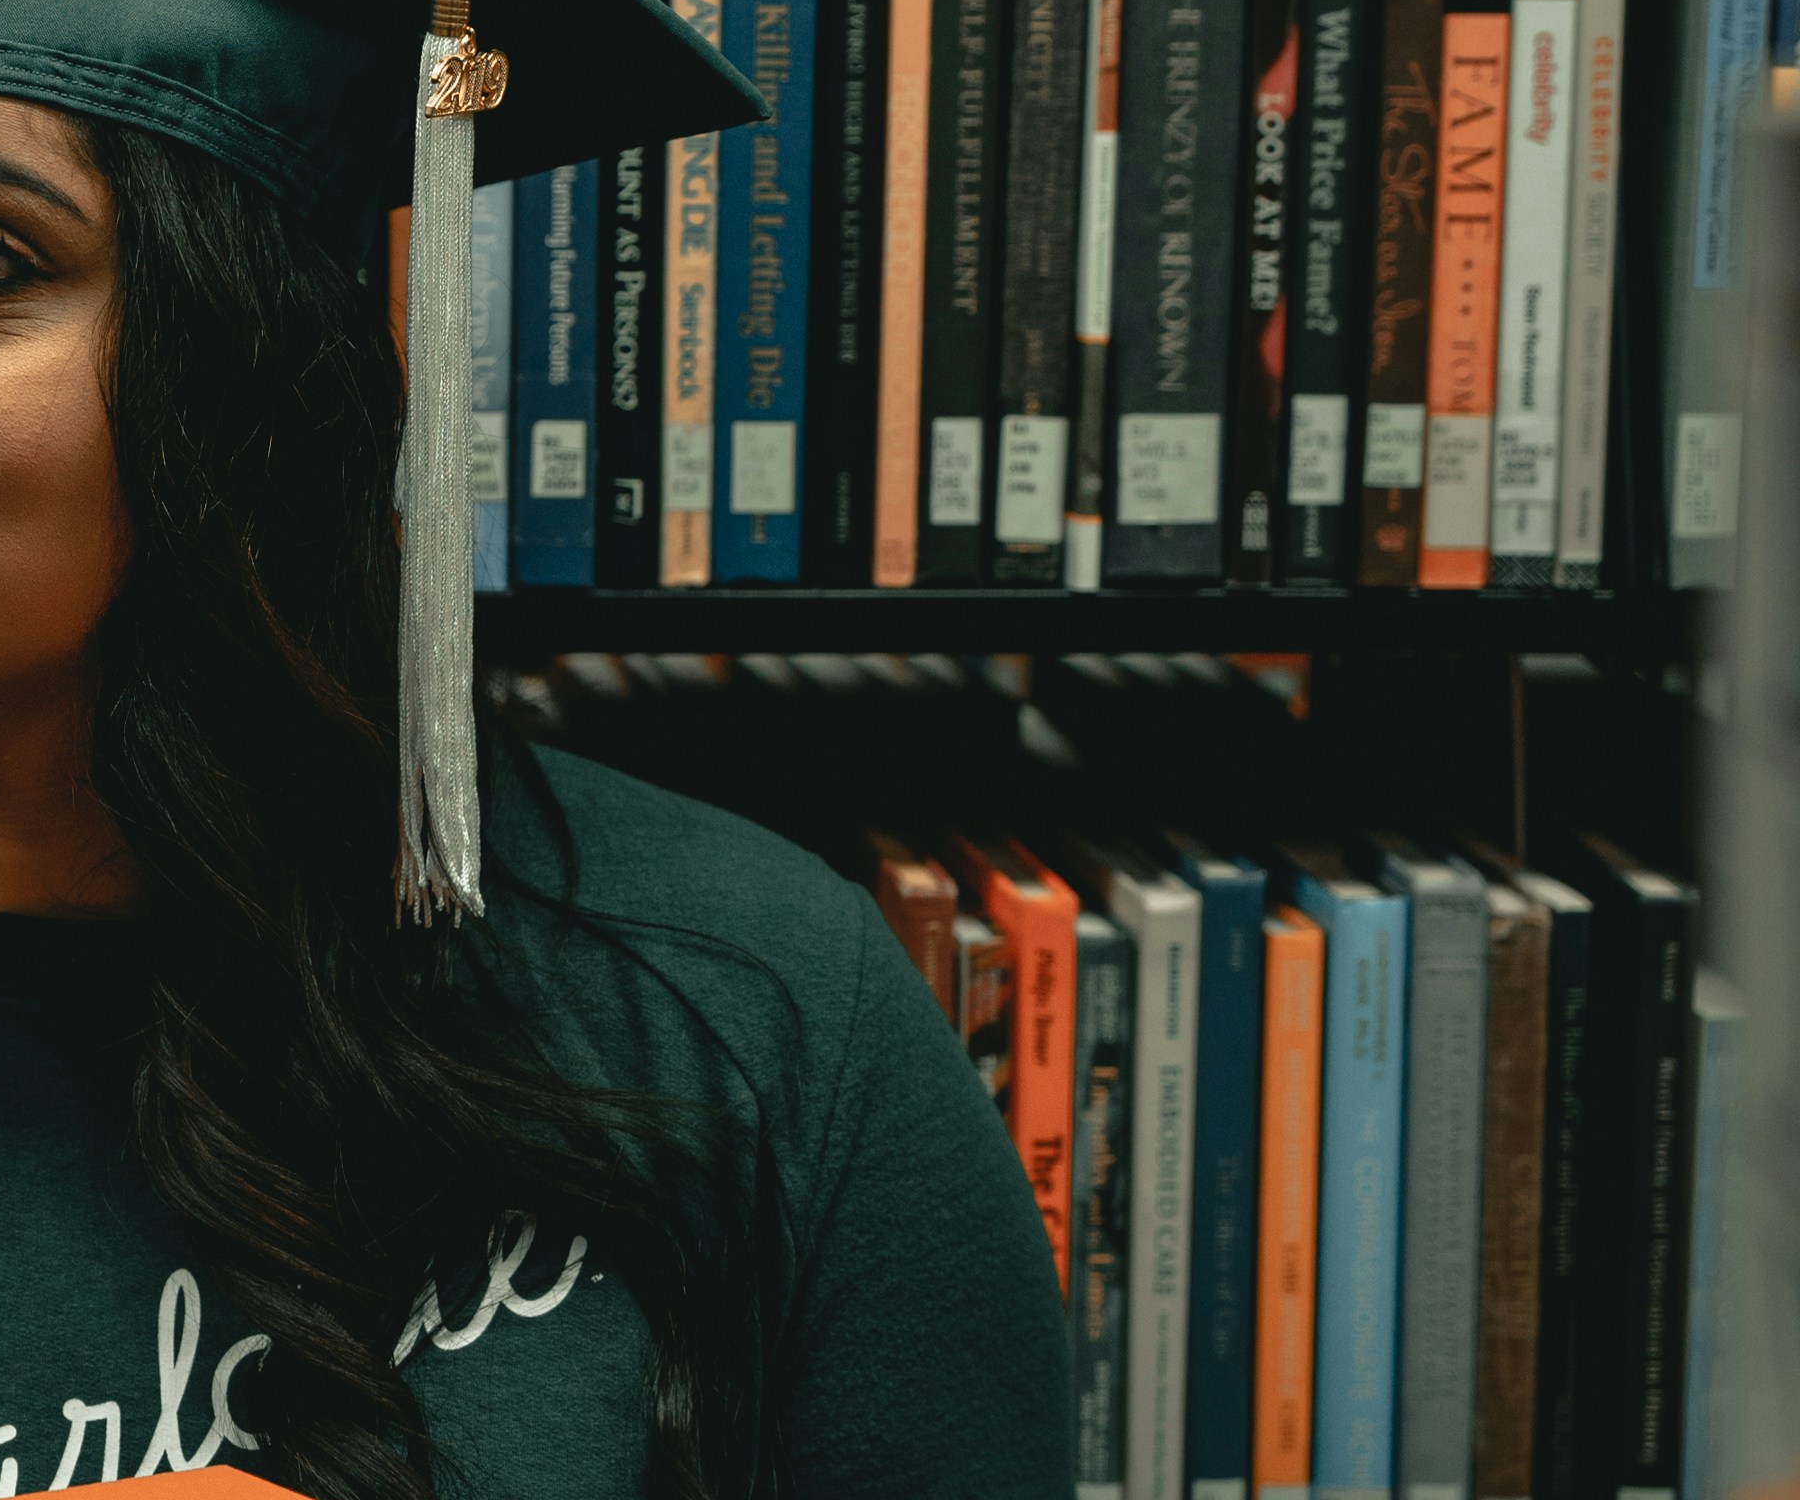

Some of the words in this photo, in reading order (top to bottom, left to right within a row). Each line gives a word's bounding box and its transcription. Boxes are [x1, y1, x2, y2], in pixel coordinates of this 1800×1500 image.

[1311, 7, 1353, 110] What
[1383, 60, 1438, 132] The
[1523, 32, 1556, 144] celebrity
[844, 80, 867, 145] HIGH
[1161, 40, 1202, 171] FRENZY
[1254, 92, 1287, 186] LOOK
[1589, 36, 1615, 184] CELEBRITY
[752, 135, 790, 202] and
[1308, 119, 1350, 211] Price
[1442, 54, 1500, 246] FAME
[681, 203, 715, 257] DIE
[1162, 173, 1199, 213] OF
[1253, 194, 1282, 241] AT
[616, 228, 640, 263] AS
[839, 209, 863, 318] LETTING
[1584, 191, 1608, 280] SOCIETY
[550, 249, 576, 310] Future
[739, 214, 786, 337] Letting
[1155, 230, 1195, 393] RENOWN
[1250, 249, 1283, 312] ME!
[1300, 218, 1345, 337] Fame?
[1524, 286, 1543, 325] Sean
[549, 312, 576, 387] Persons
[612, 269, 648, 412] PERSONS?
[676, 282, 707, 403] Steinbock
[748, 345, 785, 411] Die
[837, 323, 859, 367] DIE
[1519, 332, 1541, 411] Redmond
[1030, 1134, 1063, 1196] The
[1154, 1063, 1184, 1221] EMBODIED
[1153, 1224, 1181, 1298] CARE
